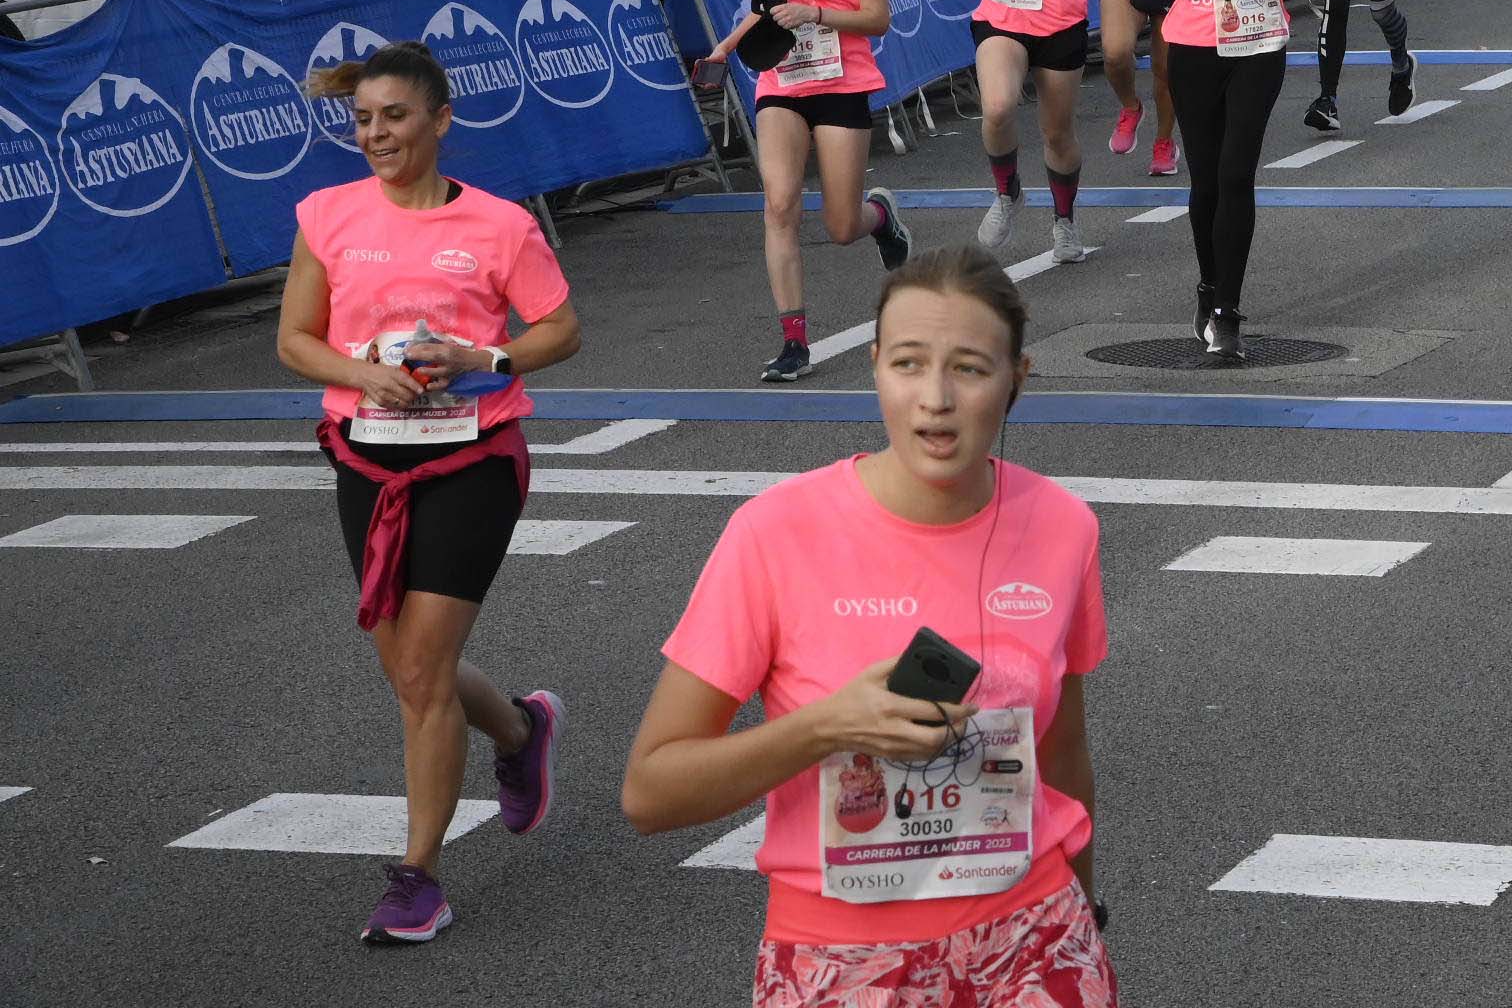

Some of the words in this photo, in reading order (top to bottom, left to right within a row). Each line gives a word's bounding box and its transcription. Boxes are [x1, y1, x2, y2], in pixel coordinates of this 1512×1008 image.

[626, 16, 658, 30] CENTRAL
[1242, 13, 1266, 25] 016
[532, 32, 562, 45] CENTRAL
[562, 28, 592, 42] LECHERA
[620, 23, 680, 66] ASTUR
[472, 41, 504, 56] LECHERA
[526, 38, 609, 83] ASTURIANA
[445, 58, 520, 99] STURIANA
[213, 89, 254, 107] CENTRAL
[254, 83, 290, 99] LECHERA
[82, 120, 124, 142] CENTRAL
[202, 99, 306, 153] ASTURIANA
[344, 249, 391, 263] OYSHO
[435, 256, 475, 269] ASTURIANA
[363, 425, 399, 435] OYSHO
[834, 597, 917, 616] OYSHO
[992, 598, 1048, 612] ASTURIANA
[983, 735, 1020, 746] SUMA
[894, 784, 962, 811] 016
[900, 818, 953, 837] 30030
[846, 846, 902, 861] CARRERA
[905, 845, 920, 856] DE
[922, 843, 938, 854] LA
[941, 839, 981, 851] MUJER
[985, 837, 1012, 849] 2023
[956, 864, 1018, 880] Santander
[841, 873, 904, 889] OYSHO
